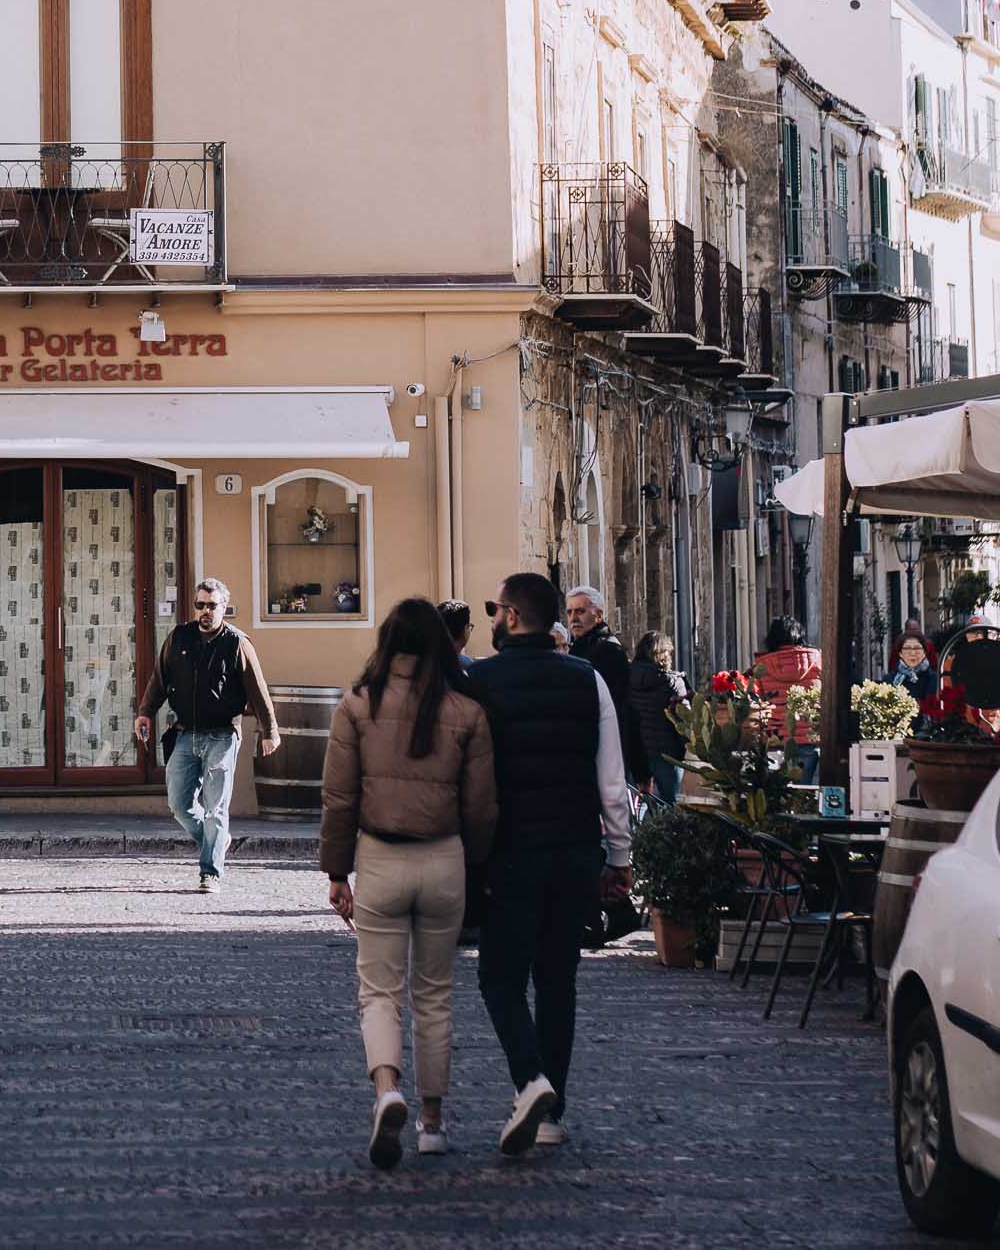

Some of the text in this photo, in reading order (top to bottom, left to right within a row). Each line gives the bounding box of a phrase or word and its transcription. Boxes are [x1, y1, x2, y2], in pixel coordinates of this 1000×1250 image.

[140, 218, 204, 234] VACANZE
[146, 234, 202, 250] AMORE
[20, 326, 119, 357] Porta
[20, 358, 163, 382] Gelateria
[225, 476, 233, 491] 6
